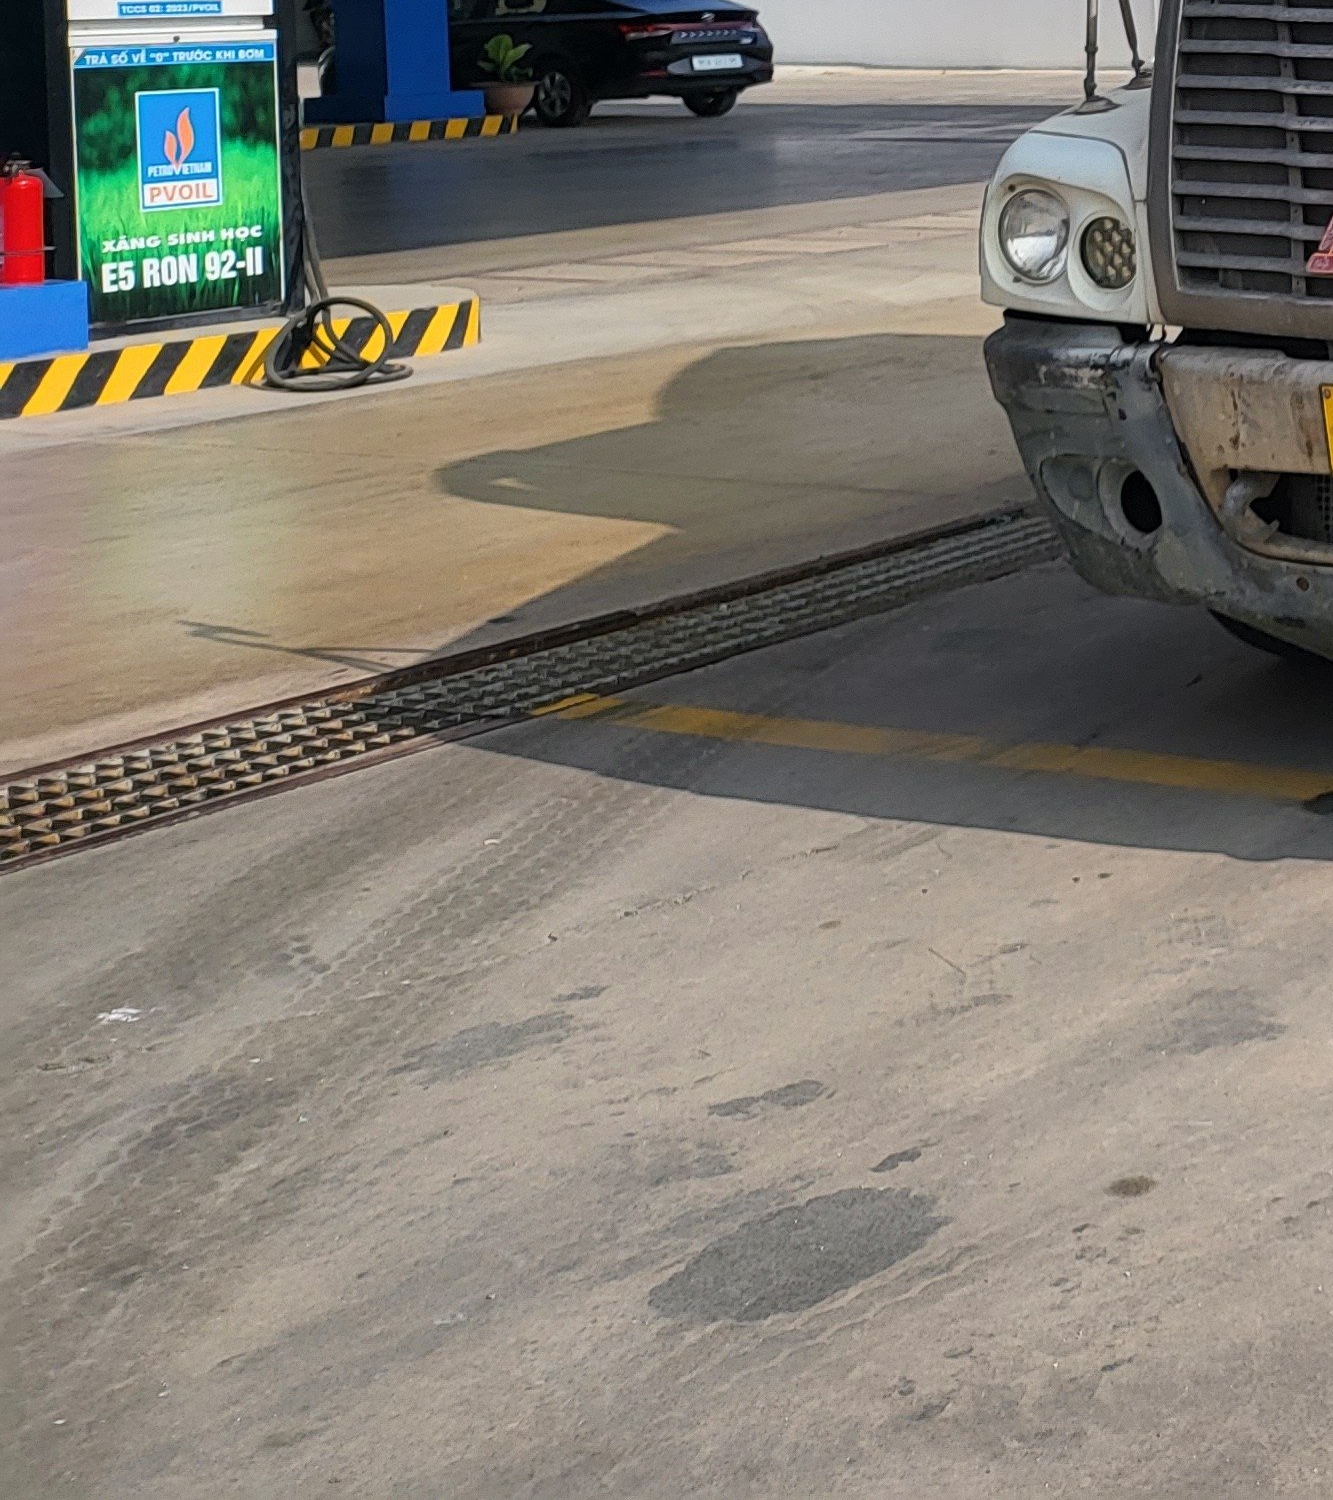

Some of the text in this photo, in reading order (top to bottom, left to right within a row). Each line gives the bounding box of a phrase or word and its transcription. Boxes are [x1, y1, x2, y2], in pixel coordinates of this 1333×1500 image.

[111, 50, 128, 64] SỐ
[216, 49, 235, 60] KHI
[238, 48, 264, 59] BƠM
[149, 182, 214, 202] PVOIL
[102, 225, 262, 253] XĂNG SINH HỌC
[101, 246, 264, 293] E5 RON 92-II
